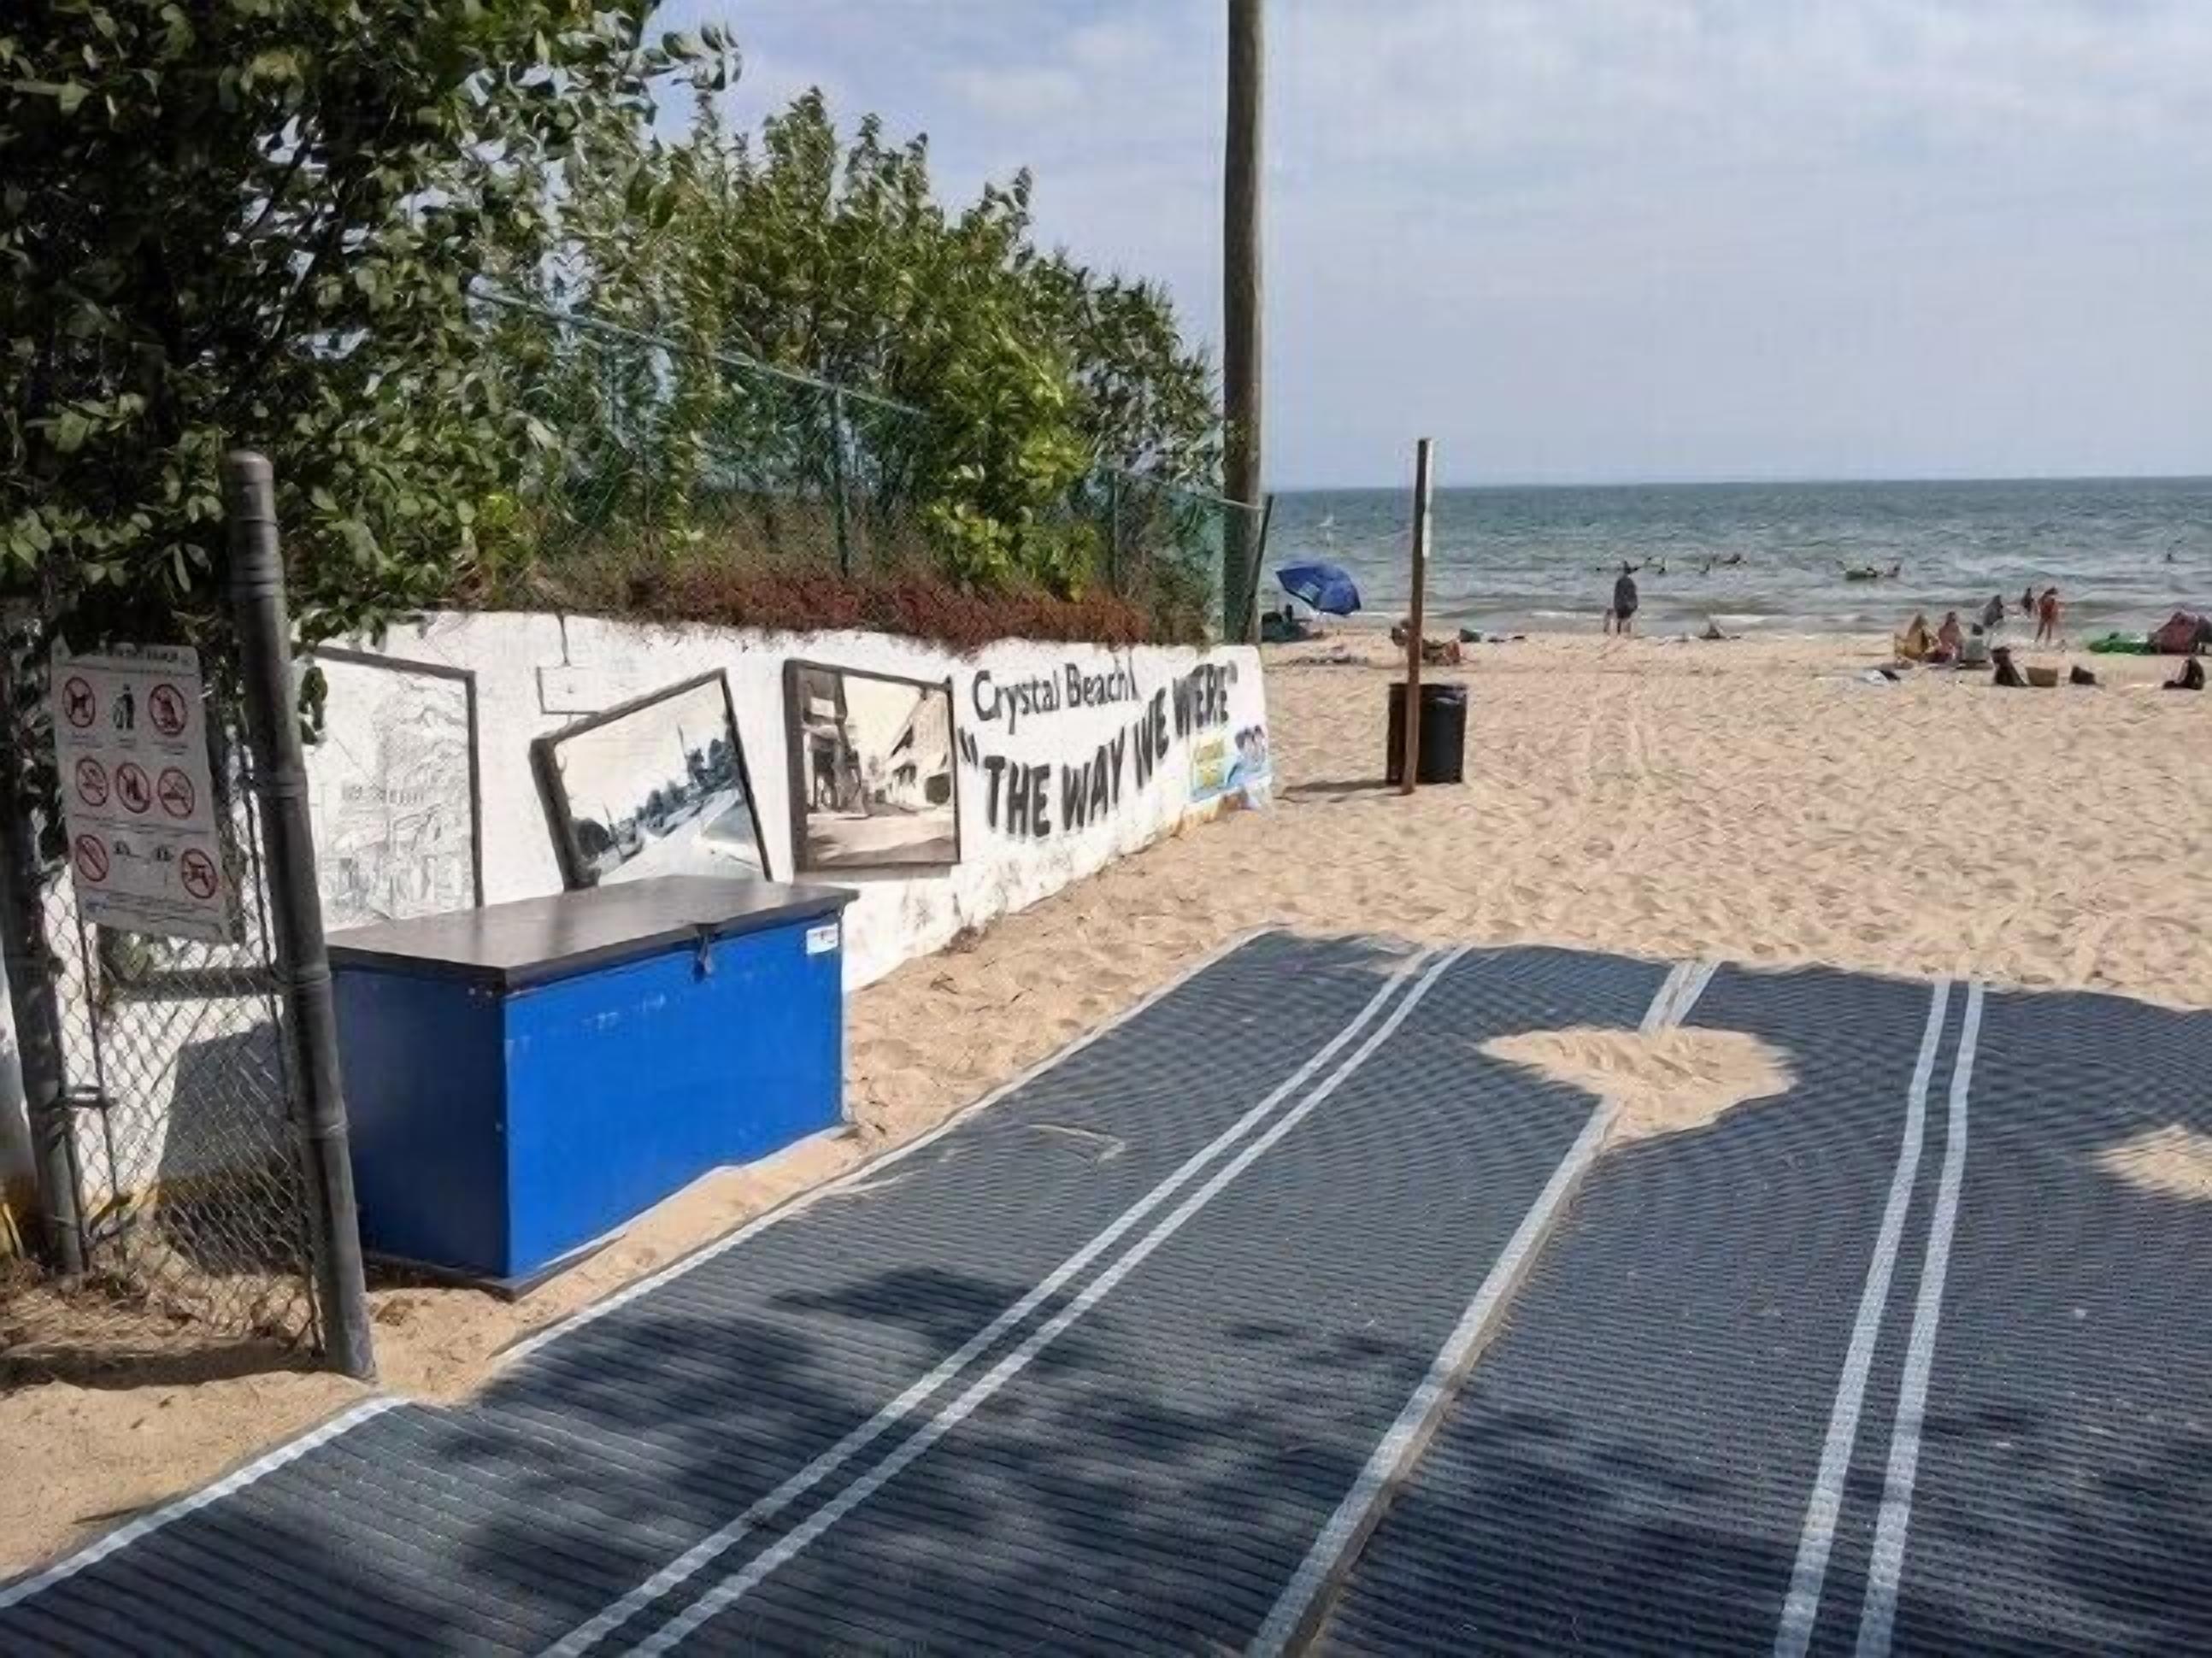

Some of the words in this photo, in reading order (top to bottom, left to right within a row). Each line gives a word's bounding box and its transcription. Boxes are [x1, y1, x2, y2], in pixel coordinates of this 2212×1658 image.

[973, 669, 1060, 736] Crystal
[1065, 656, 1131, 708] Beach
[1062, 726, 1126, 832] WAY
[1134, 687, 1168, 789] WE
